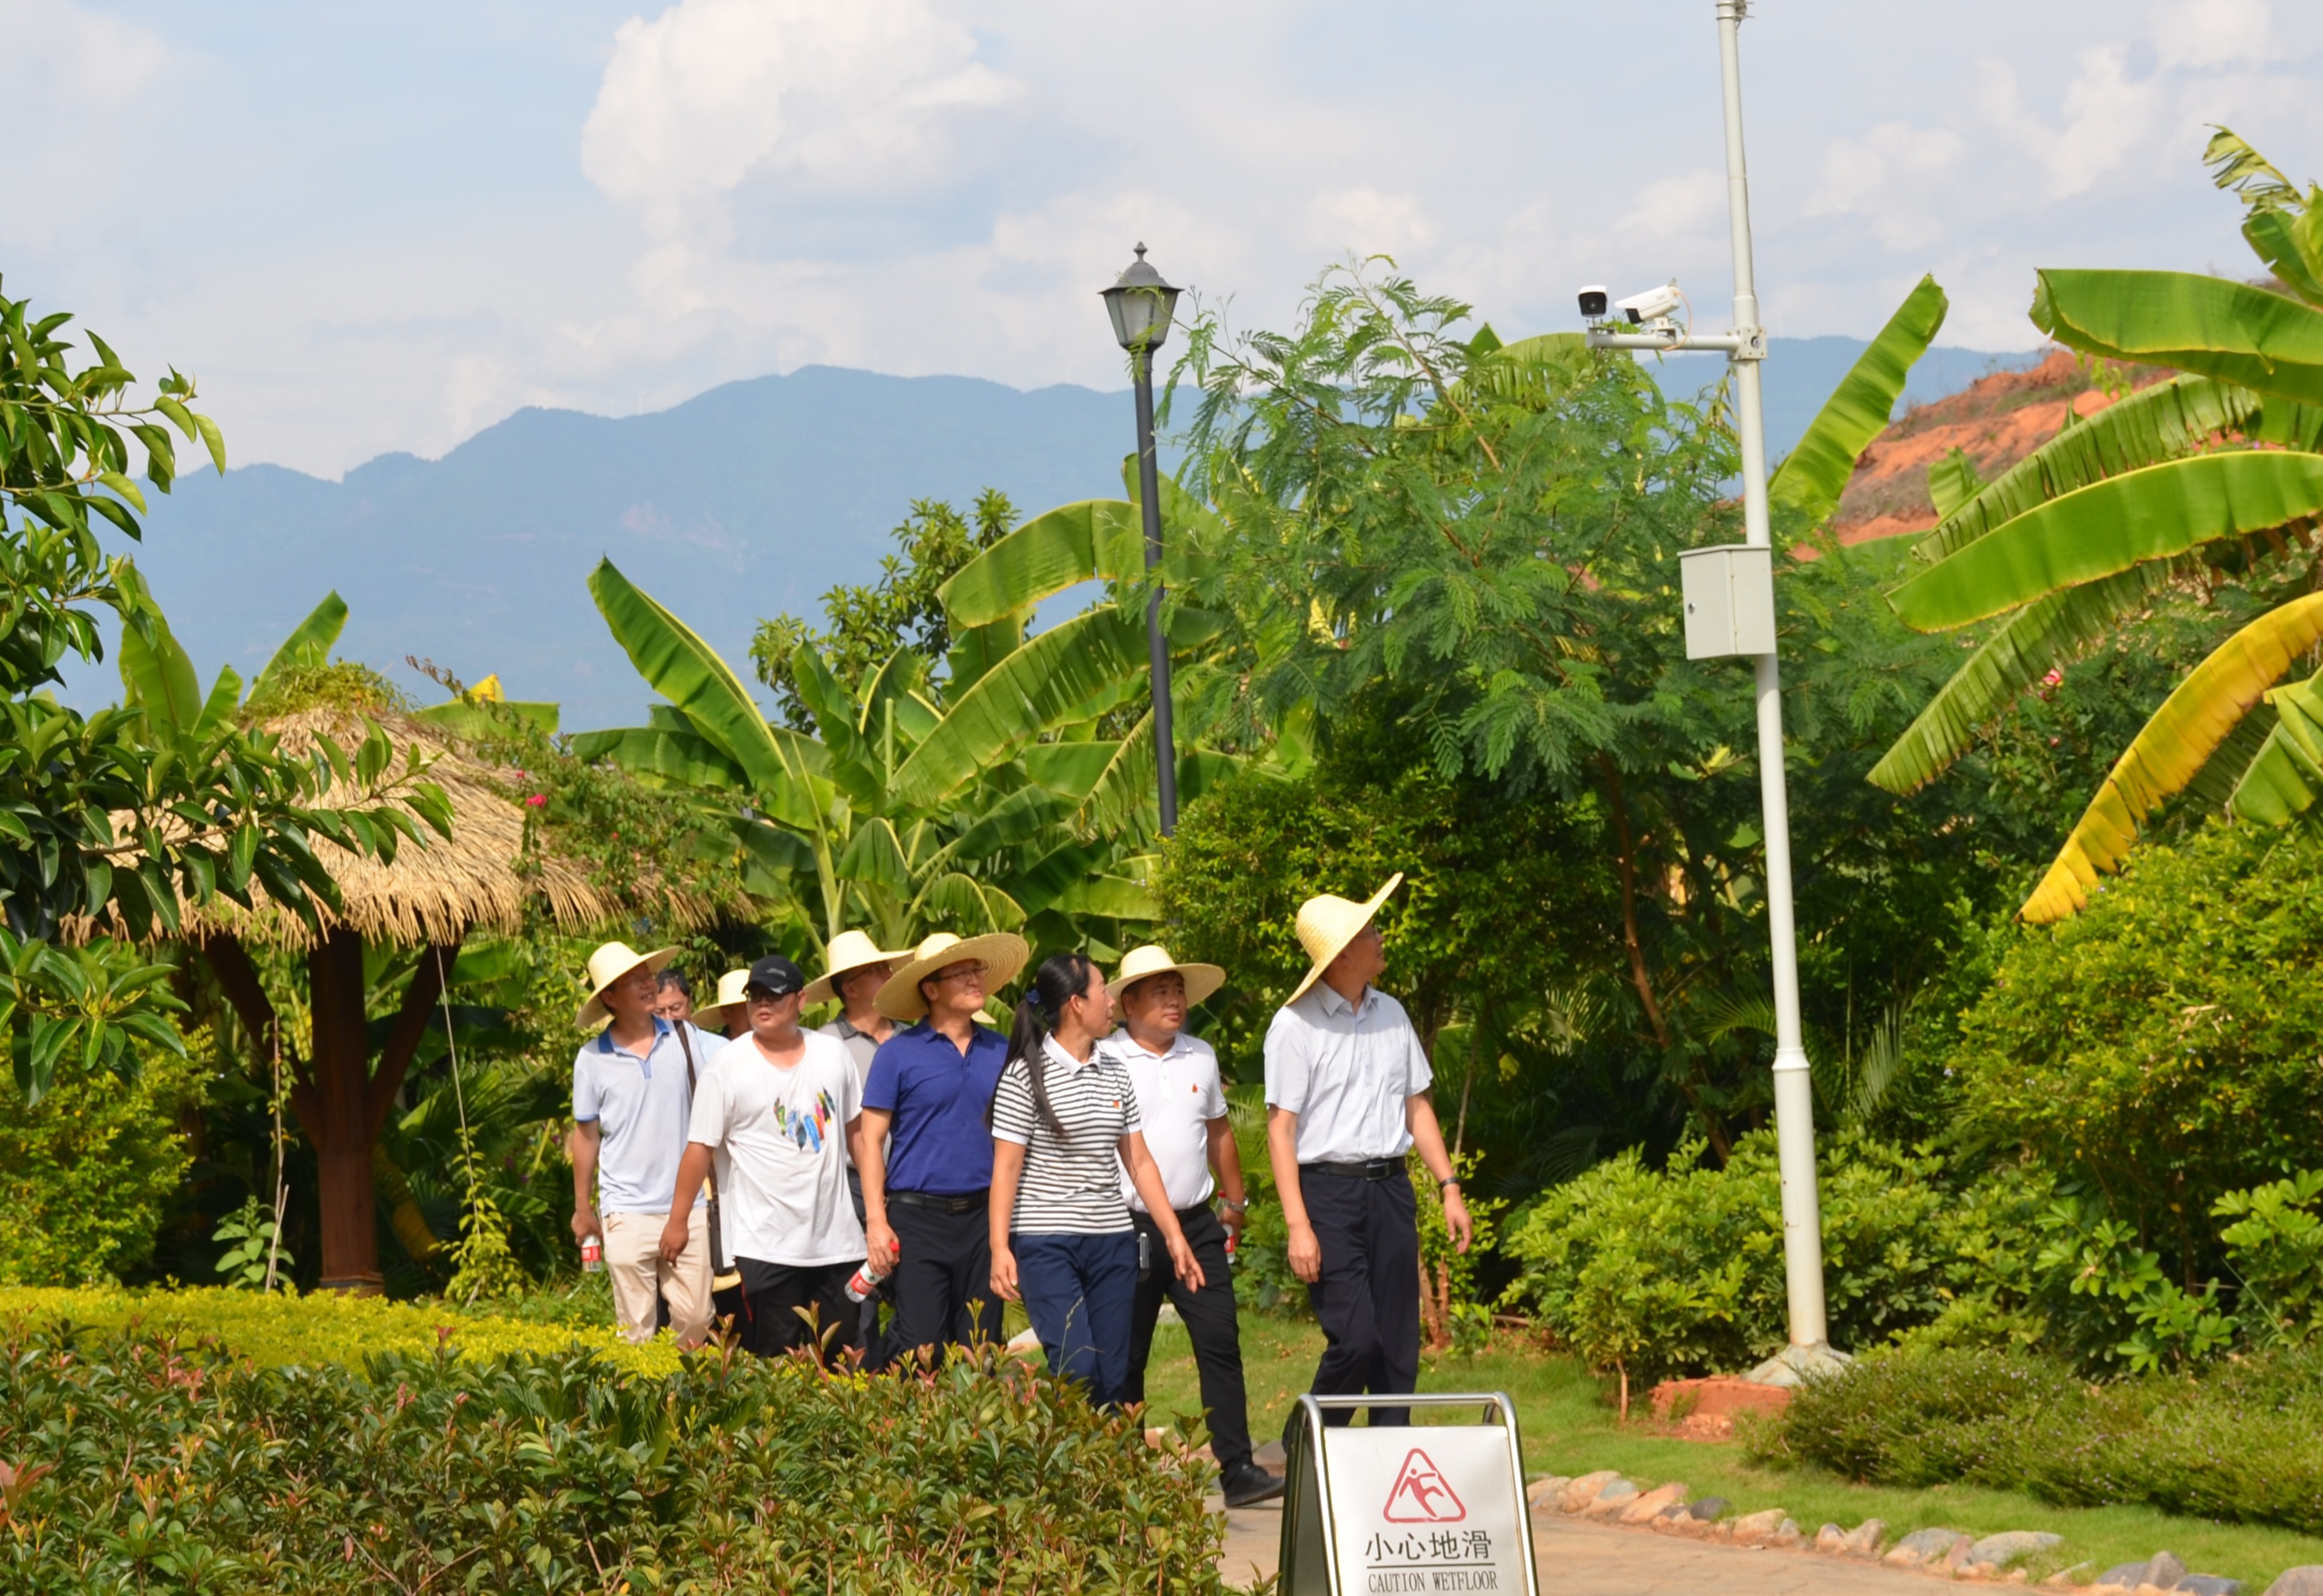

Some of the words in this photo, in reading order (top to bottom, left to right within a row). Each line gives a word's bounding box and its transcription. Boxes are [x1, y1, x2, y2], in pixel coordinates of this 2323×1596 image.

[1365, 1530, 1492, 1561] 小心地滑
[1368, 1572, 1425, 1593] CAUTION
[1432, 1570, 1498, 1591] WETFLOOR
